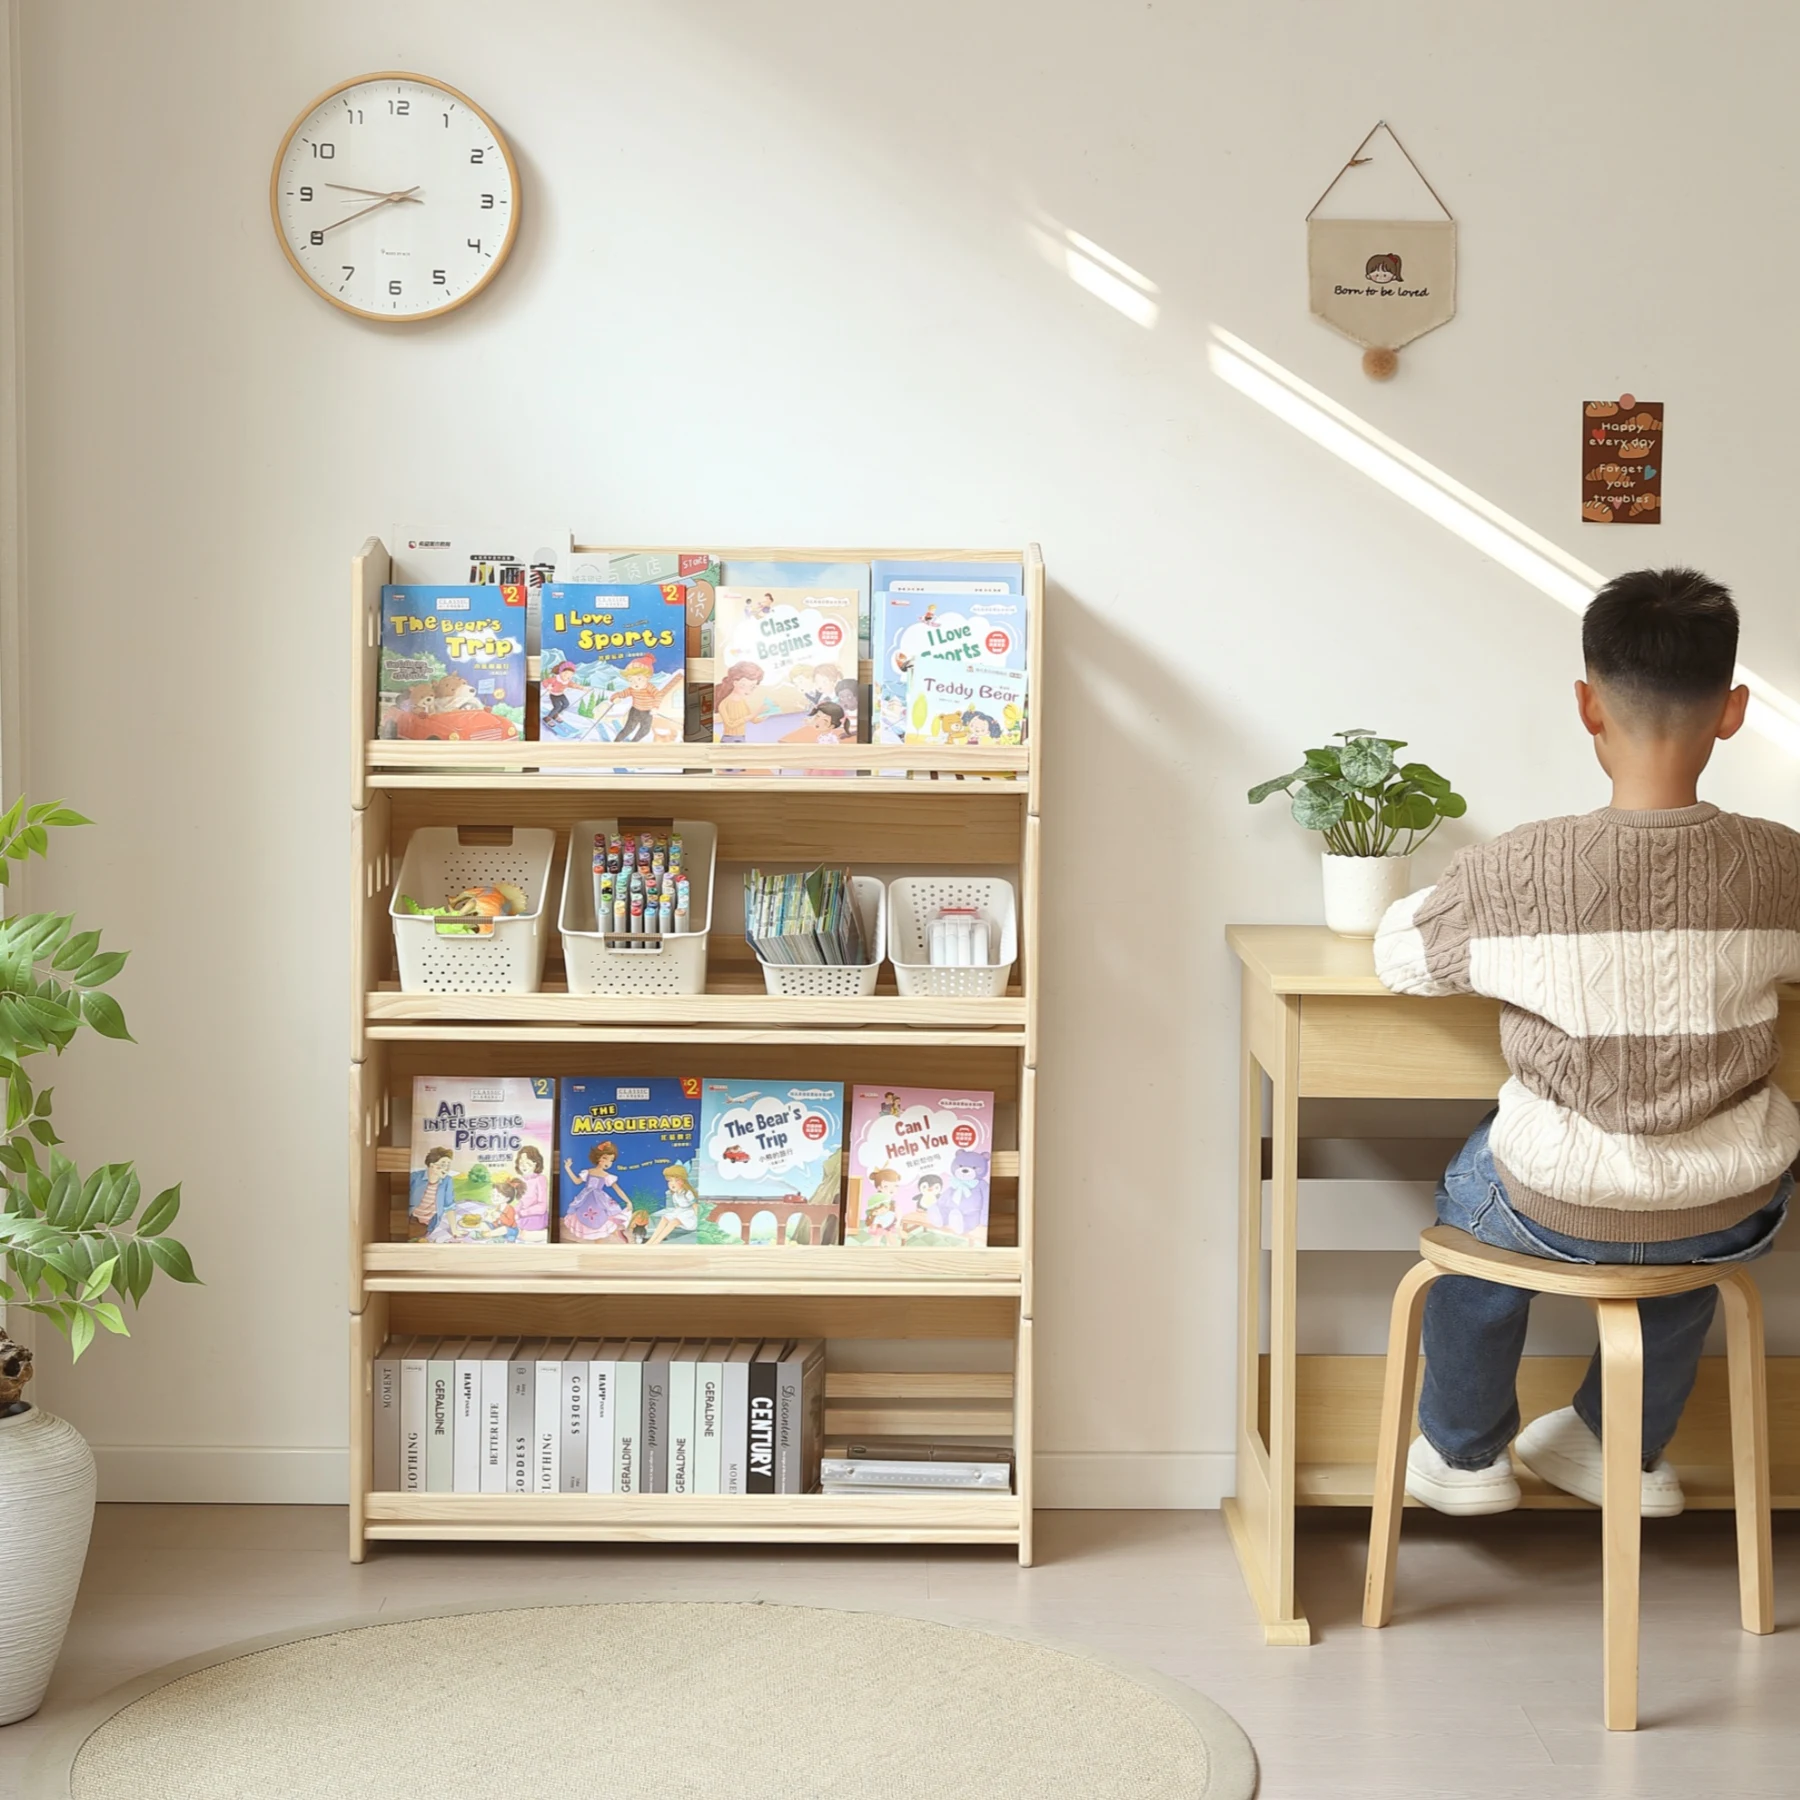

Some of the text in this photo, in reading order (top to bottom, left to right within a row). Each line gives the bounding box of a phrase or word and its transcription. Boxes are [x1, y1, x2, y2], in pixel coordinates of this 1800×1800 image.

[347, 109, 364, 125] 11
[387, 100, 410, 115] 12
[442, 113, 449, 128] 1
[311, 143, 335, 159] 10
[470, 149, 484, 164] 2
[300, 186, 313, 202] 9
[480, 194, 494, 209] 3
[310, 230, 324, 246] 8
[467, 238, 481, 253] 4
[341, 266, 355, 281] 7
[432, 270, 446, 285] 5
[388, 280, 402, 295] 6
[1334, 285, 1430, 297] Born to be loved
[1601, 422, 1645, 434] Happy
[1631, 438, 1656, 449] day
[1606, 481, 1636, 490] your
[1593, 494, 1649, 503] troubles
[682, 556, 708, 569] STORE
[390, 616, 502, 636] The Bear's
[554, 613, 566, 632] I
[570, 610, 614, 626] Love
[760, 617, 800, 637] Class
[577, 629, 675, 651] Sports
[927, 631, 935, 646] I
[936, 625, 972, 644] Love
[445, 636, 513, 658] Trip
[756, 633, 813, 660] Begins
[921, 643, 981, 662] orts
[924, 678, 1020, 703] Teddy Bear
[437, 1101, 465, 1117] An
[591, 1105, 616, 1115] THE
[424, 1116, 523, 1130] INTERESTING
[573, 1116, 692, 1133] MASQUERADE
[724, 1119, 754, 1138] The
[756, 1105, 802, 1131] Bear's
[895, 1115, 930, 1136] Can I
[455, 1130, 521, 1150] Picnic
[755, 1130, 788, 1150] Trip
[885, 1139, 919, 1159] Help
[921, 1134, 949, 1150] You
[383, 1368, 392, 1409] MOMENT
[435, 1379, 445, 1435] GERALDINE
[571, 1376, 581, 1435] GODDESS
[704, 1381, 715, 1437] GERALDINE
[489, 1403, 499, 1465] BETTER LIFE
[751, 1397, 773, 1476] CENTURY
[408, 1432, 418, 1492] LOTHING
[516, 1437, 526, 1492] ODDESS
[542, 1433, 552, 1493] LOTHING
[621, 1437, 632, 1493] GERALDINE
[676, 1438, 686, 1493] GERALDINE
